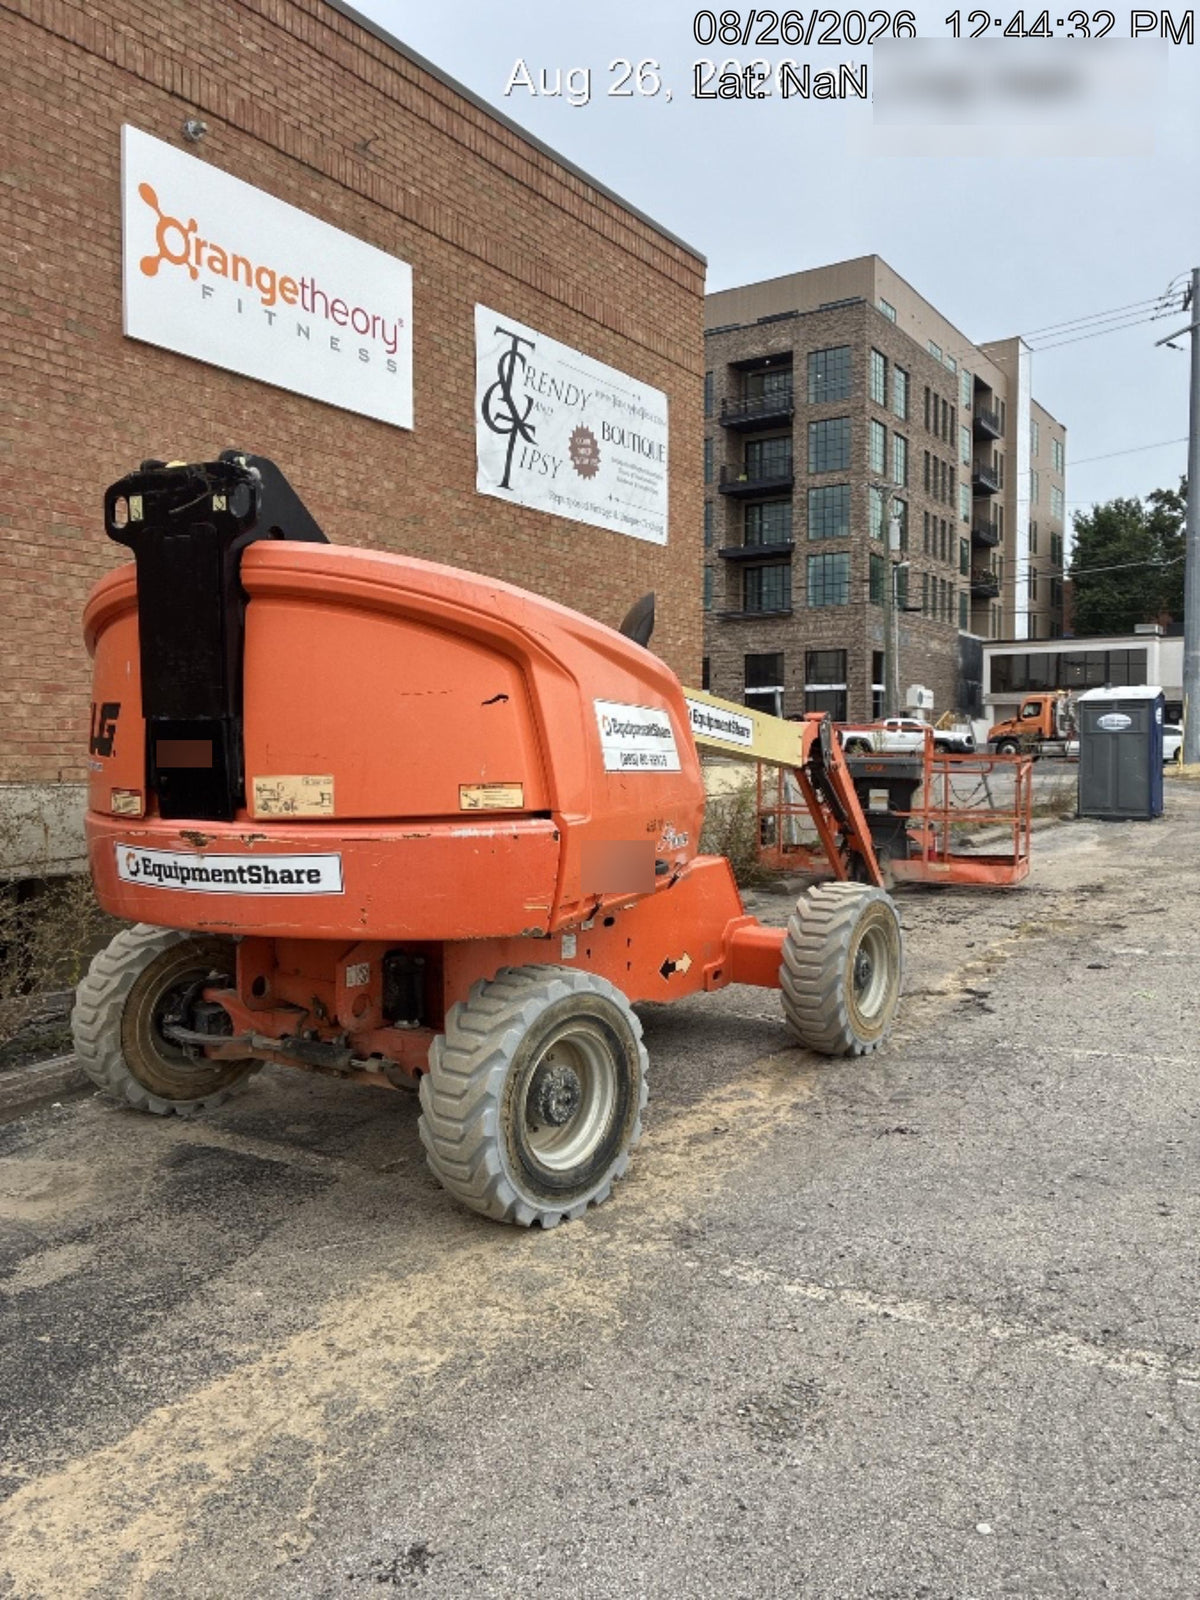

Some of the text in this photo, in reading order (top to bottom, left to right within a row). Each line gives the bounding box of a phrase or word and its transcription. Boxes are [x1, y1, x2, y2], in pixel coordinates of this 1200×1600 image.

[201, 284, 398, 374] FITNESS
[602, 420, 666, 463] BOUTIQUE
[89, 702, 121, 757] LG
[142, 857, 321, 885] EquipmentShare
